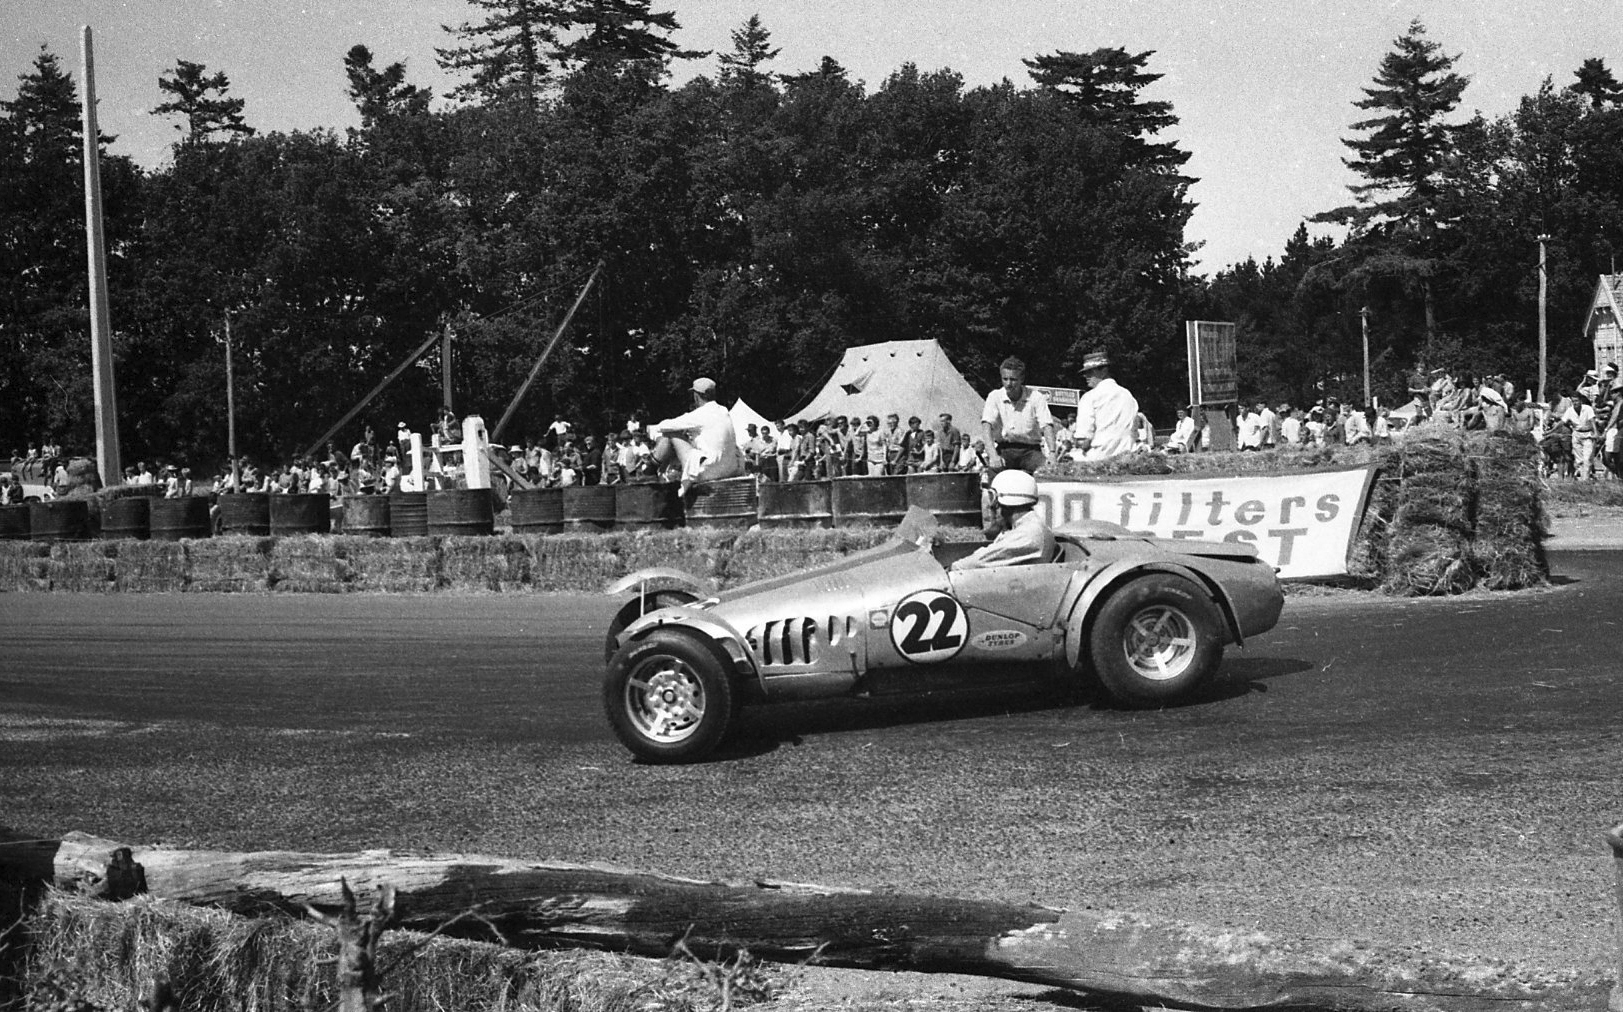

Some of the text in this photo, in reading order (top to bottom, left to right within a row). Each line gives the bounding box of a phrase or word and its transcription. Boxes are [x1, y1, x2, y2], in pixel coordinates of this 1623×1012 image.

[1118, 491, 1340, 527] filters
[897, 596, 962, 655] 22
[985, 633, 1020, 641] DUNLOP
